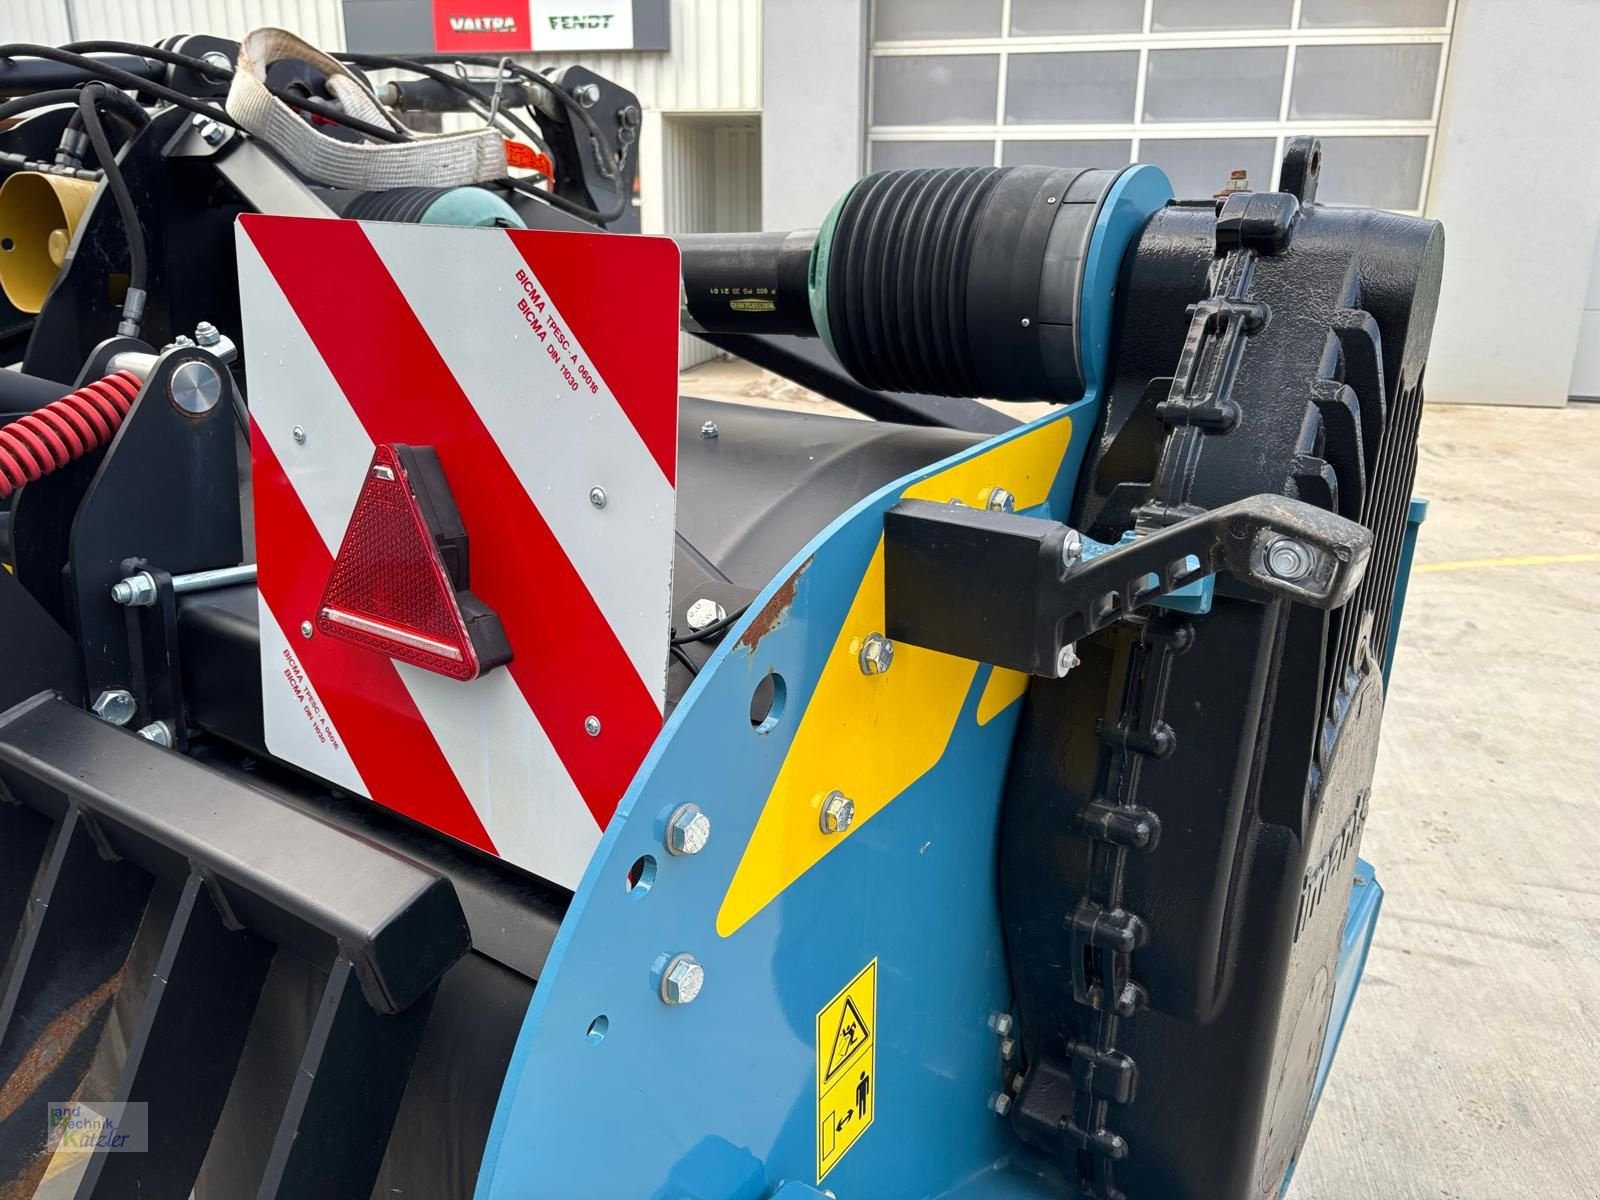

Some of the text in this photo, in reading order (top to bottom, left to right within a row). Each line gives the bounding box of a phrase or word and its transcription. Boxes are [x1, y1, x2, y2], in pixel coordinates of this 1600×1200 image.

[450, 15, 517, 32] VALTRA
[548, 14, 614, 30] FENDT
[515, 269, 546, 313] BICMA
[578, 365, 599, 394] 06016
[517, 298, 579, 391] BICMA DIN 11030
[283, 649, 303, 683] BICMA
[284, 669, 326, 743] BICMA DIN 11030
